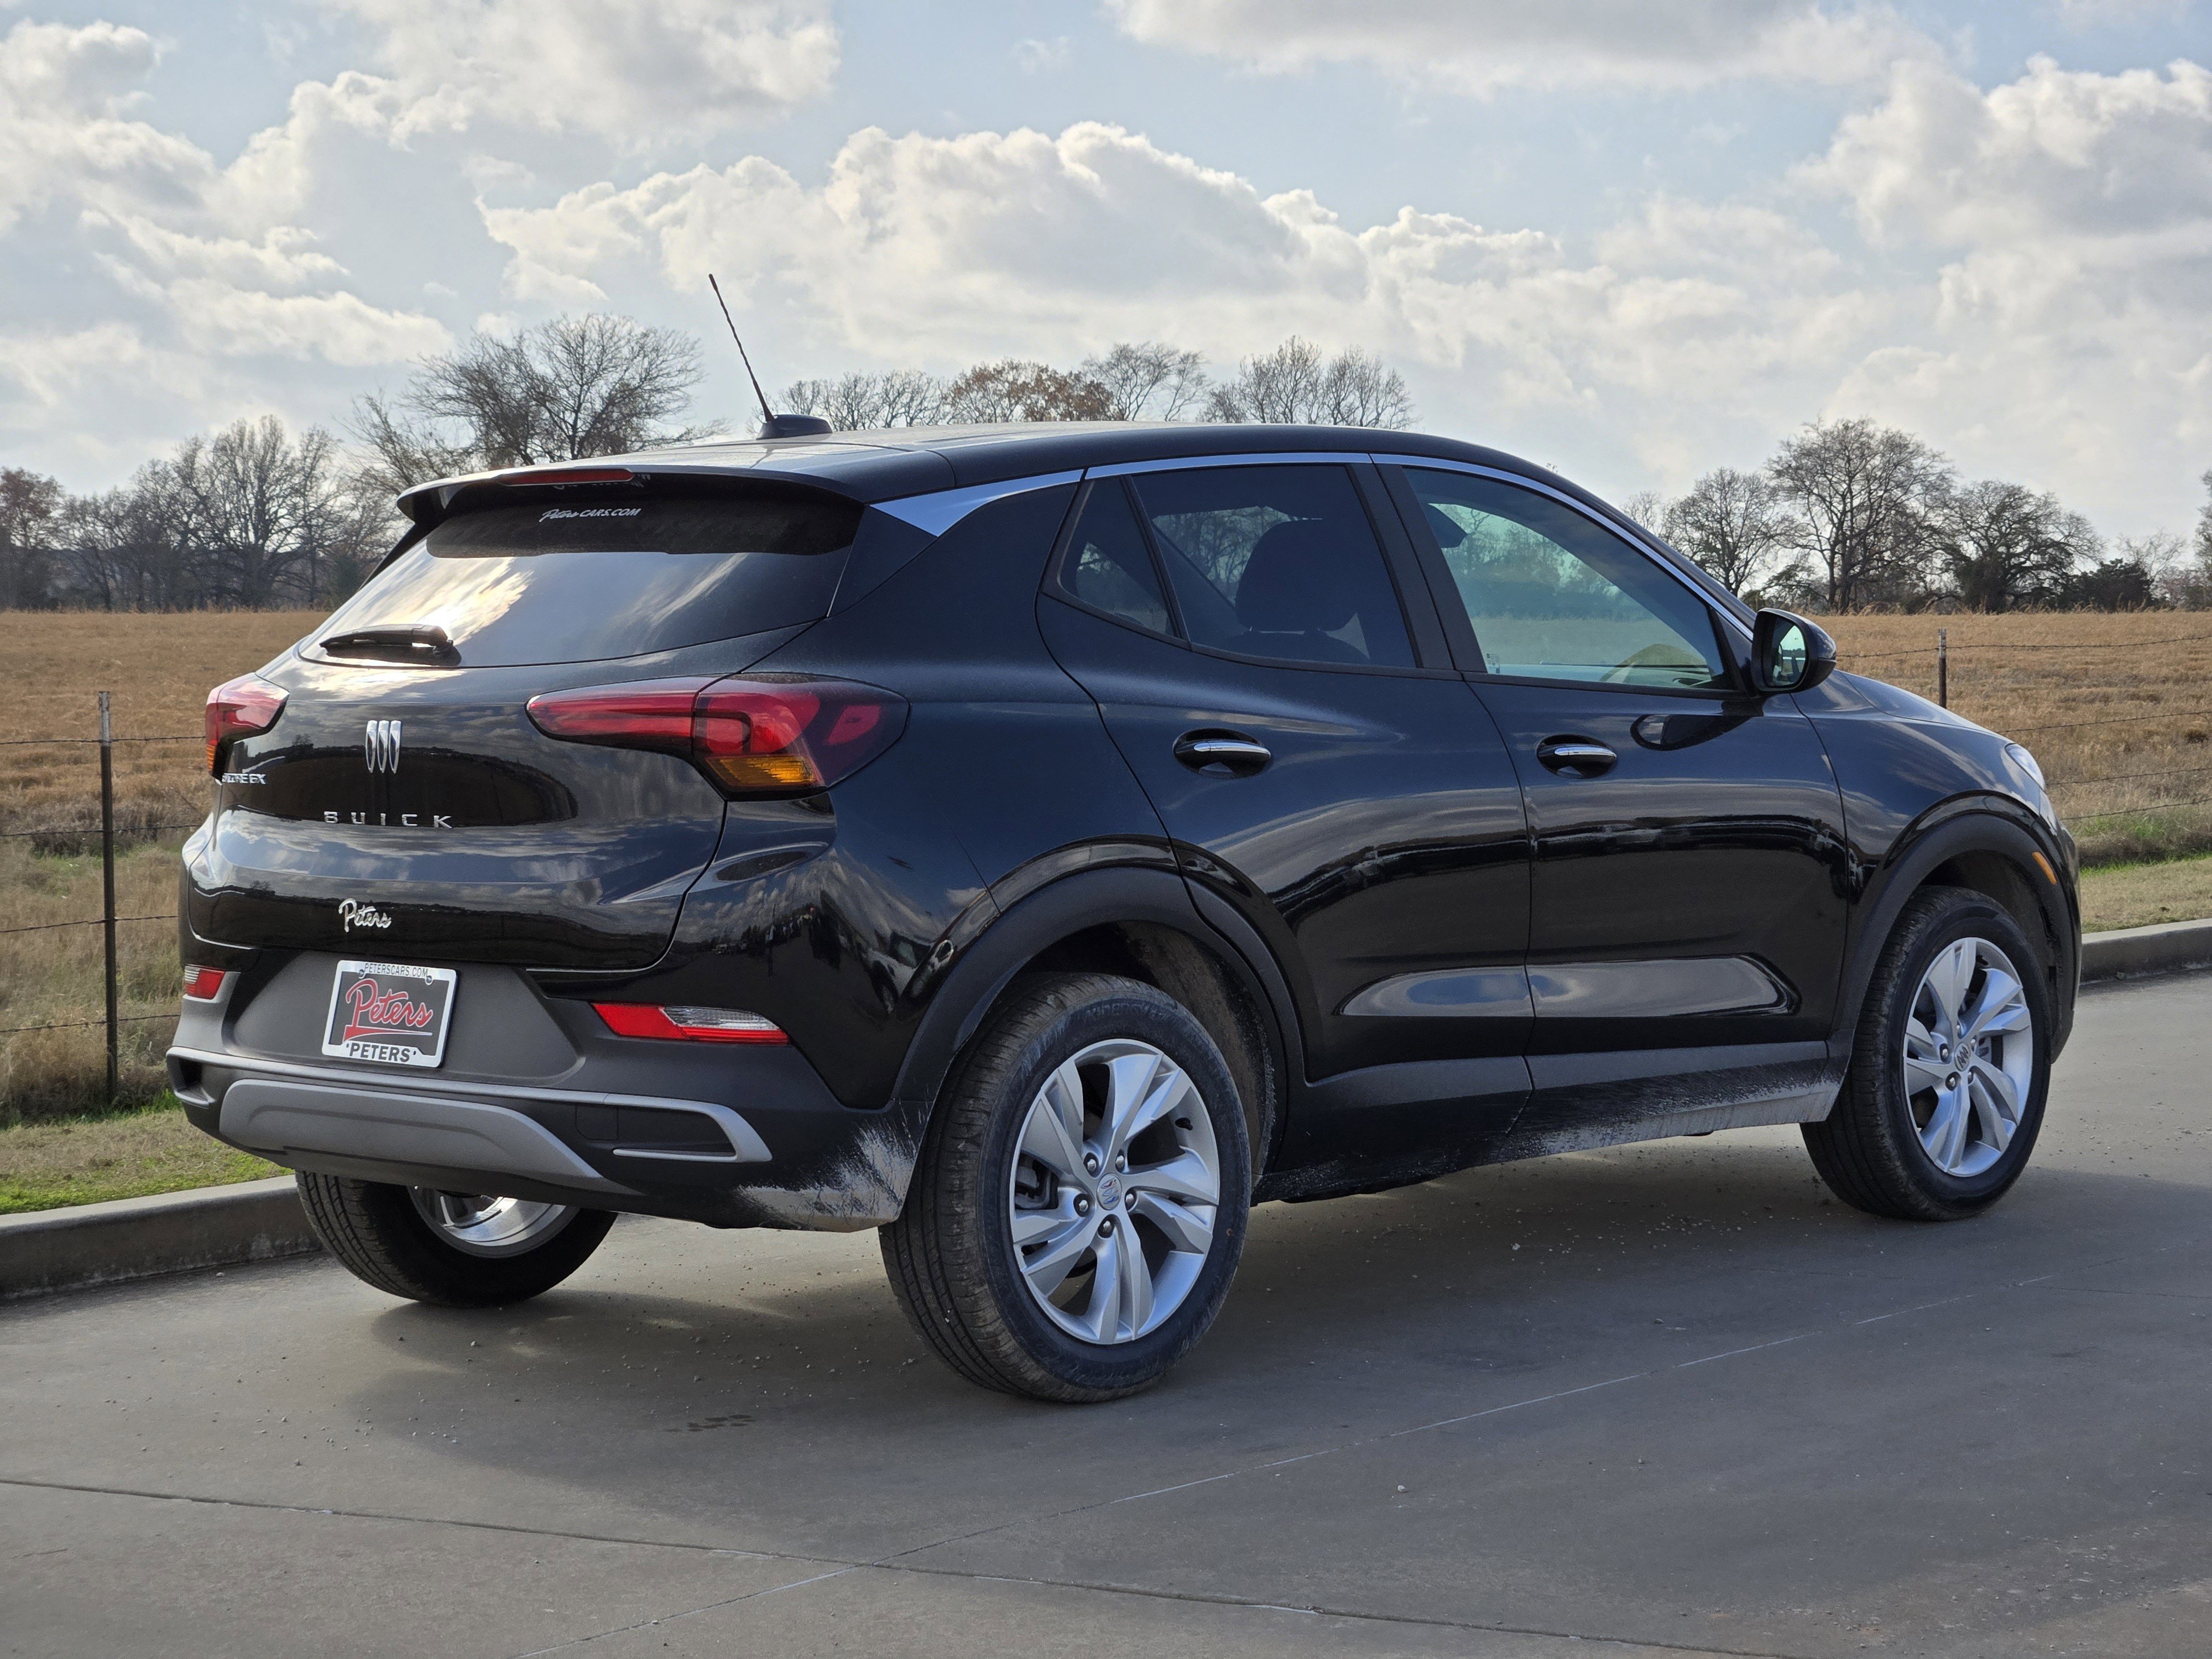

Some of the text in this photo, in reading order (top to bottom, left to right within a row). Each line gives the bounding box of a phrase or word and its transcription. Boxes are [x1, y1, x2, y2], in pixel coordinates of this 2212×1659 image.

[249, 774, 267, 785] GX
[324, 811, 452, 829] BUICK
[338, 898, 392, 932] Peters
[364, 963, 428, 977] PETERSCARS.COM
[345, 978, 434, 1027] Peters
[349, 1042, 411, 1063] PETERS
